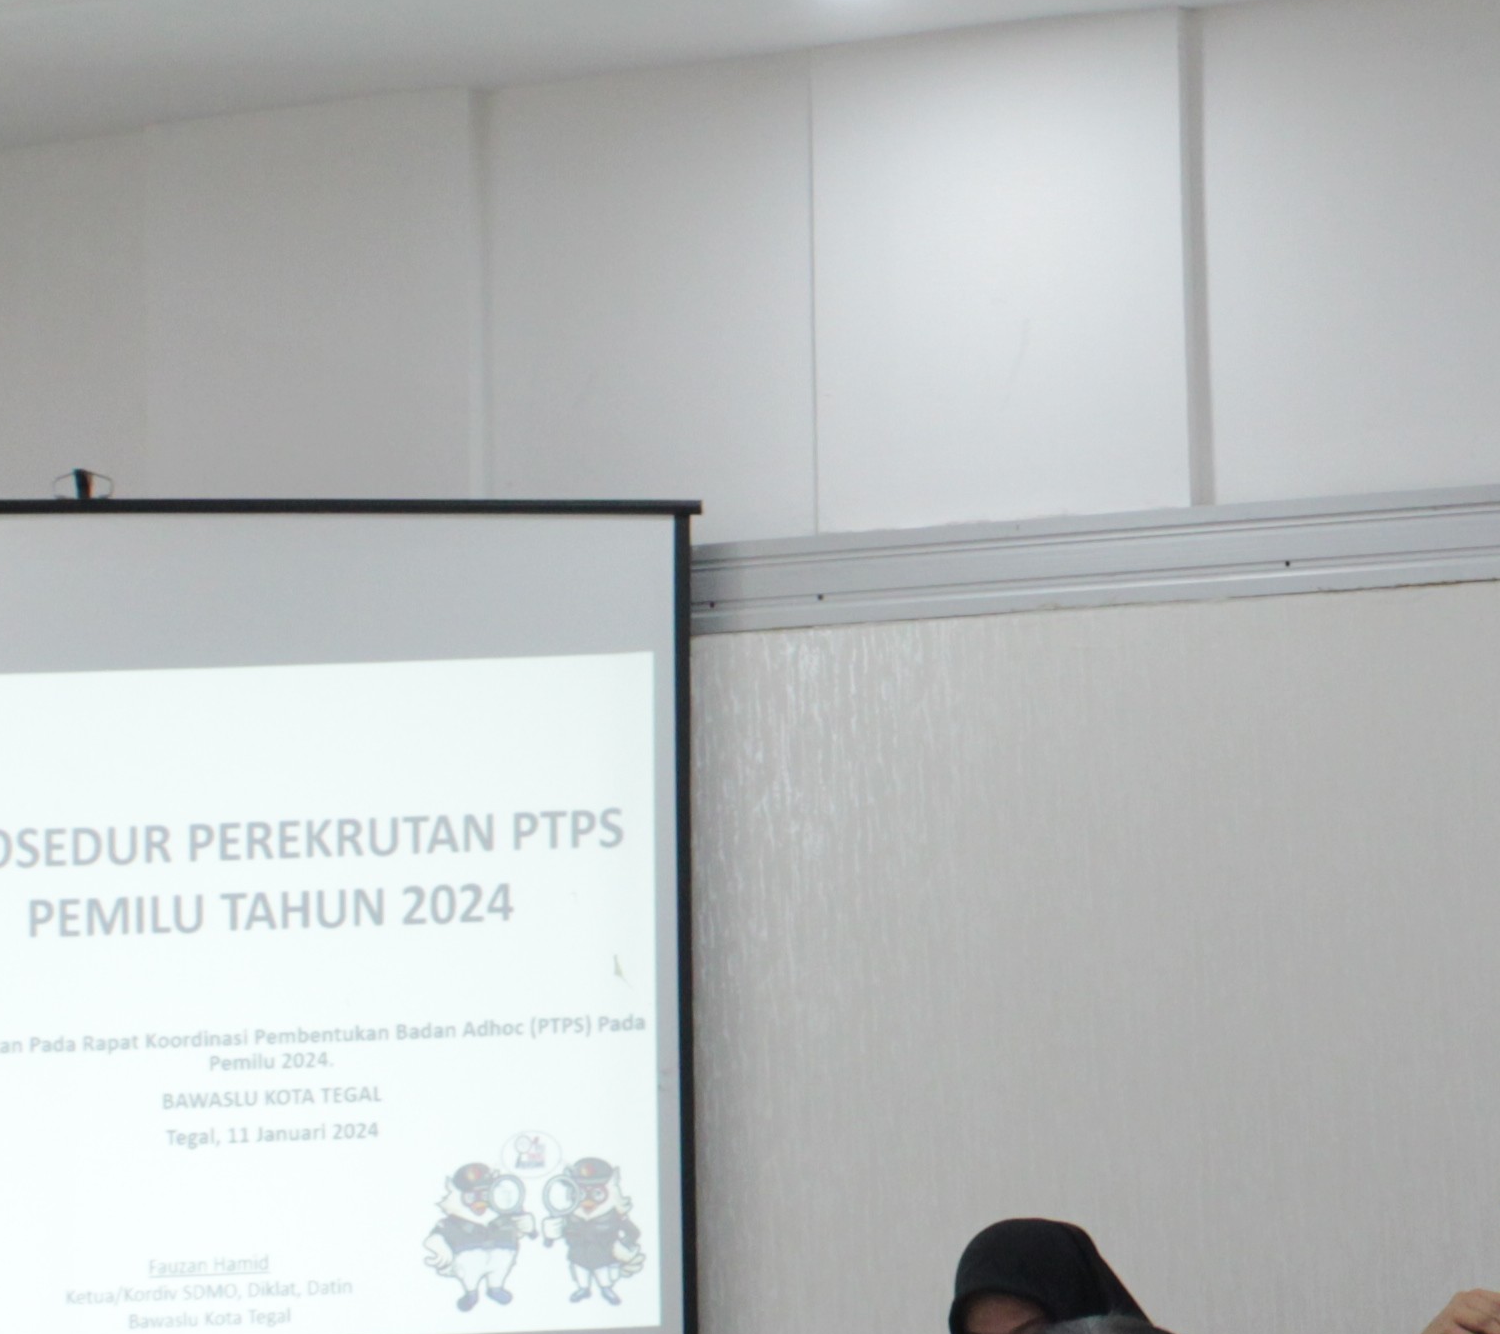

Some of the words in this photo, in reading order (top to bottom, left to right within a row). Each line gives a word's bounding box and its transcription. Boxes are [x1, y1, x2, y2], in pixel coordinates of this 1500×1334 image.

[188, 812, 495, 863] PEREKRUTAN
[512, 806, 625, 851] PTPS
[28, 893, 204, 938] PEMILU
[219, 887, 385, 932] TAHUN
[401, 882, 515, 926] 2024
[29, 1035, 77, 1053] Pada
[82, 1035, 139, 1055] Rapat
[145, 1029, 249, 1049] Koordinasi
[254, 1024, 390, 1045] Pembentukan
[395, 1021, 457, 1041] Badan
[461, 1019, 524, 1038] Adhoc
[530, 1014, 592, 1040] (PTPS)
[597, 1013, 646, 1033] Pada
[209, 1052, 276, 1072] Pemilu
[281, 1051, 334, 1070] 2024.
[162, 1090, 258, 1110] BAWASLU
[264, 1088, 315, 1106] KOTA
[320, 1086, 382, 1104] TEGAL
[165, 1127, 221, 1150] Tegal,
[228, 1127, 250, 1144] 11
[256, 1123, 326, 1143] Januari
[332, 1122, 379, 1141] 2024
[149, 1259, 209, 1275] Fauzan
[214, 1255, 269, 1272] Hamid
[65, 1285, 178, 1306] Ketua/Kordiv
[182, 1283, 242, 1301] SDMO,
[248, 1280, 302, 1299] Diklat,
[307, 1278, 353, 1296] Datin
[128, 1312, 198, 1329] Bawaslu
[204, 1311, 242, 1326] Kota
[248, 1307, 291, 1327] Tegal
